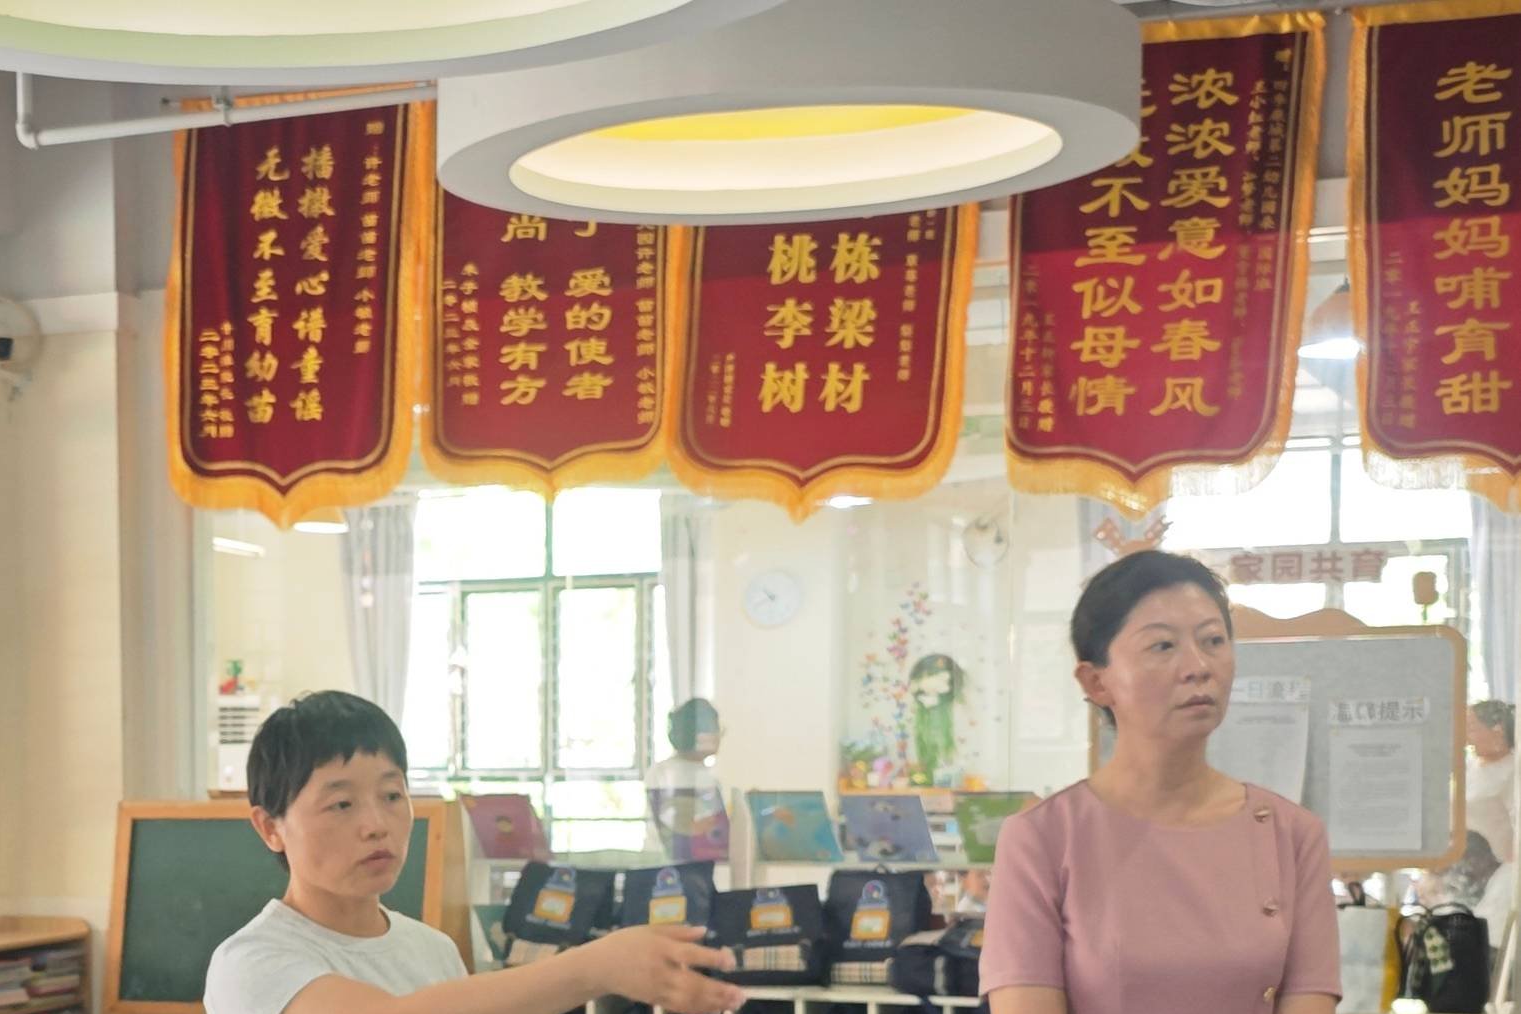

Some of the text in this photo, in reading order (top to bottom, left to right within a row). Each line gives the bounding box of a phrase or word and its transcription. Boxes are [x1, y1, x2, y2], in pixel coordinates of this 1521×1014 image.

[244, 146, 291, 424] 无微不至育幼苗
[758, 233, 819, 414] 桃李树
[819, 232, 882, 414] 栋梁材
[1148, 67, 1240, 418] 浓浓爱意如春风
[1432, 60, 1512, 415] 老师妈妈哺育甜
[499, 272, 550, 406] 教学有方
[562, 266, 616, 401] 爱的使者
[1230, 548, 1385, 584] 家园共育
